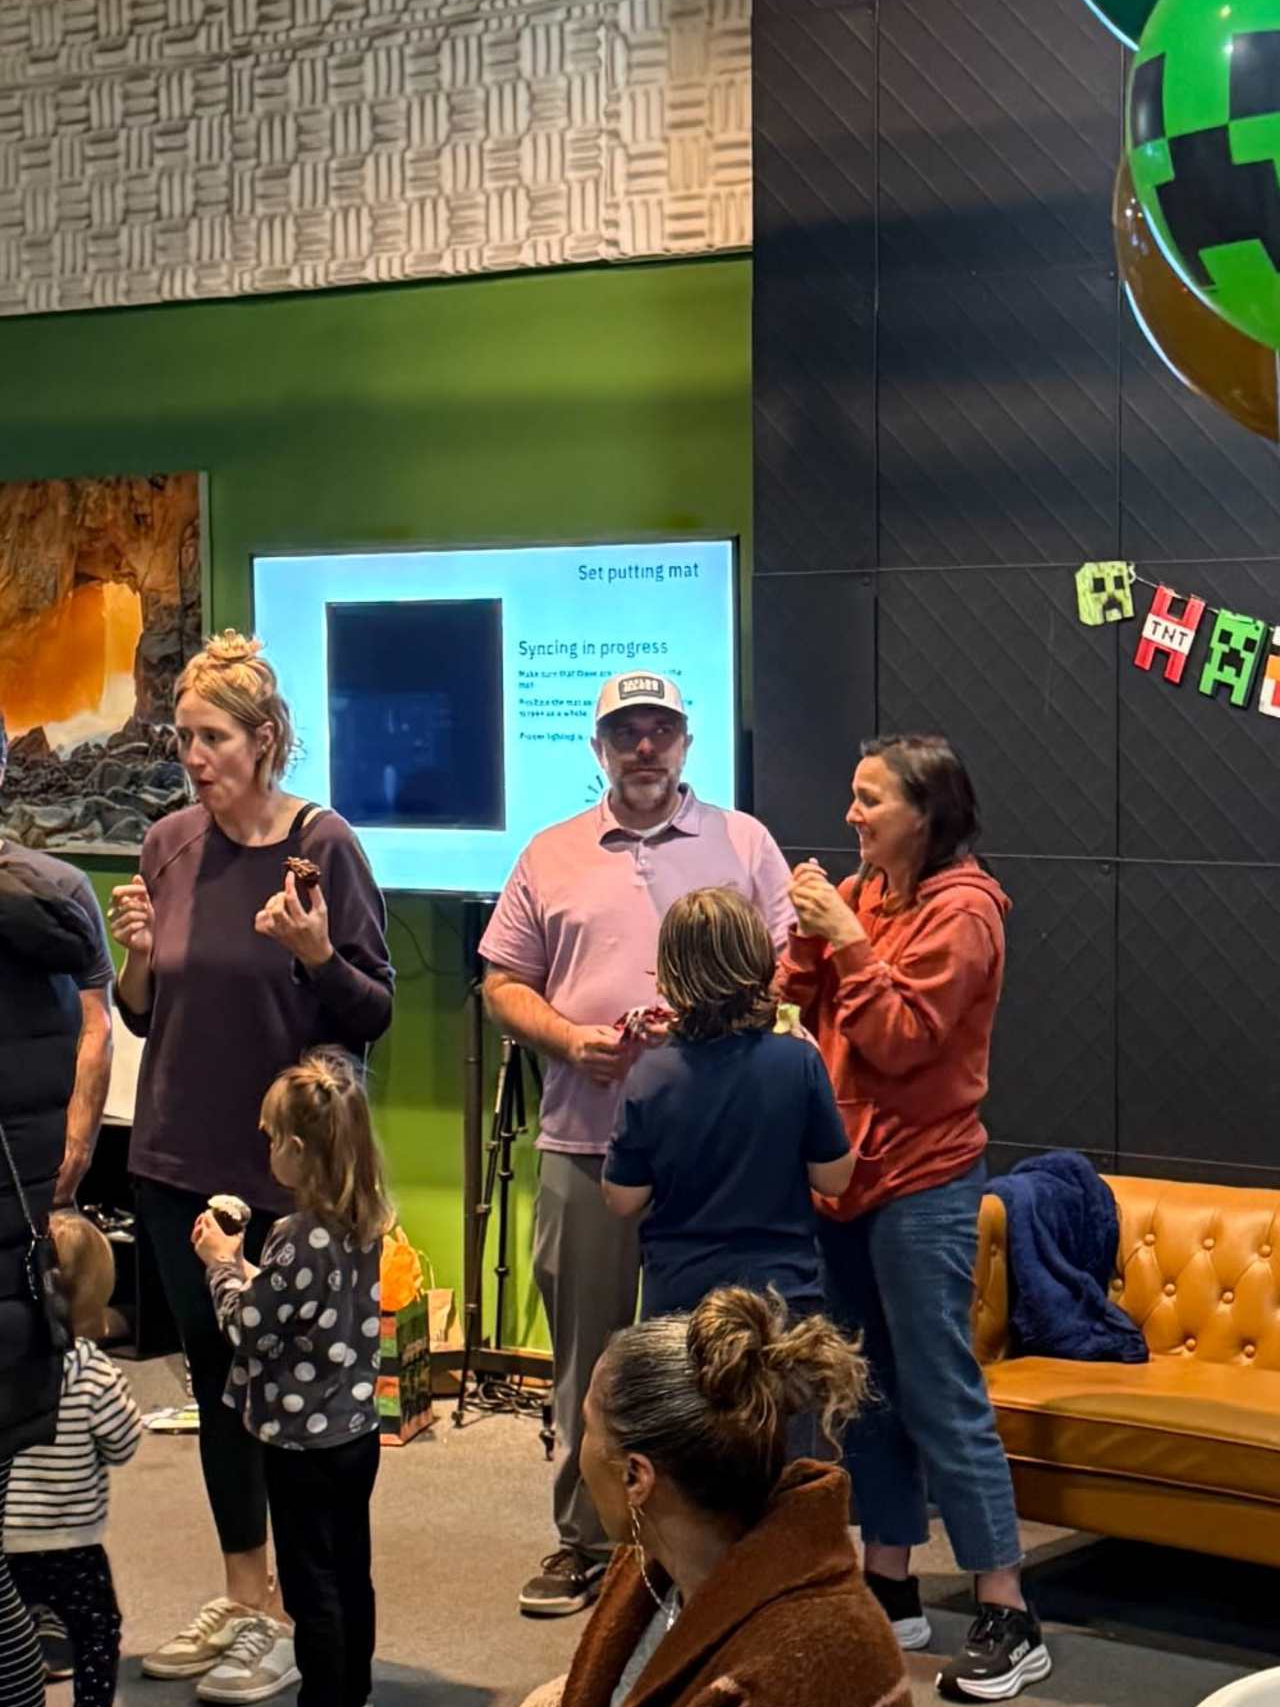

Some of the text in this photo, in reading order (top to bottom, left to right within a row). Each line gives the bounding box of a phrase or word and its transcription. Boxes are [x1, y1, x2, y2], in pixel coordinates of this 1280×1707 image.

[578, 562, 699, 584] Set putting mat
[1150, 619, 1189, 648] TNT
[518, 639, 669, 660] Syncing in progress
